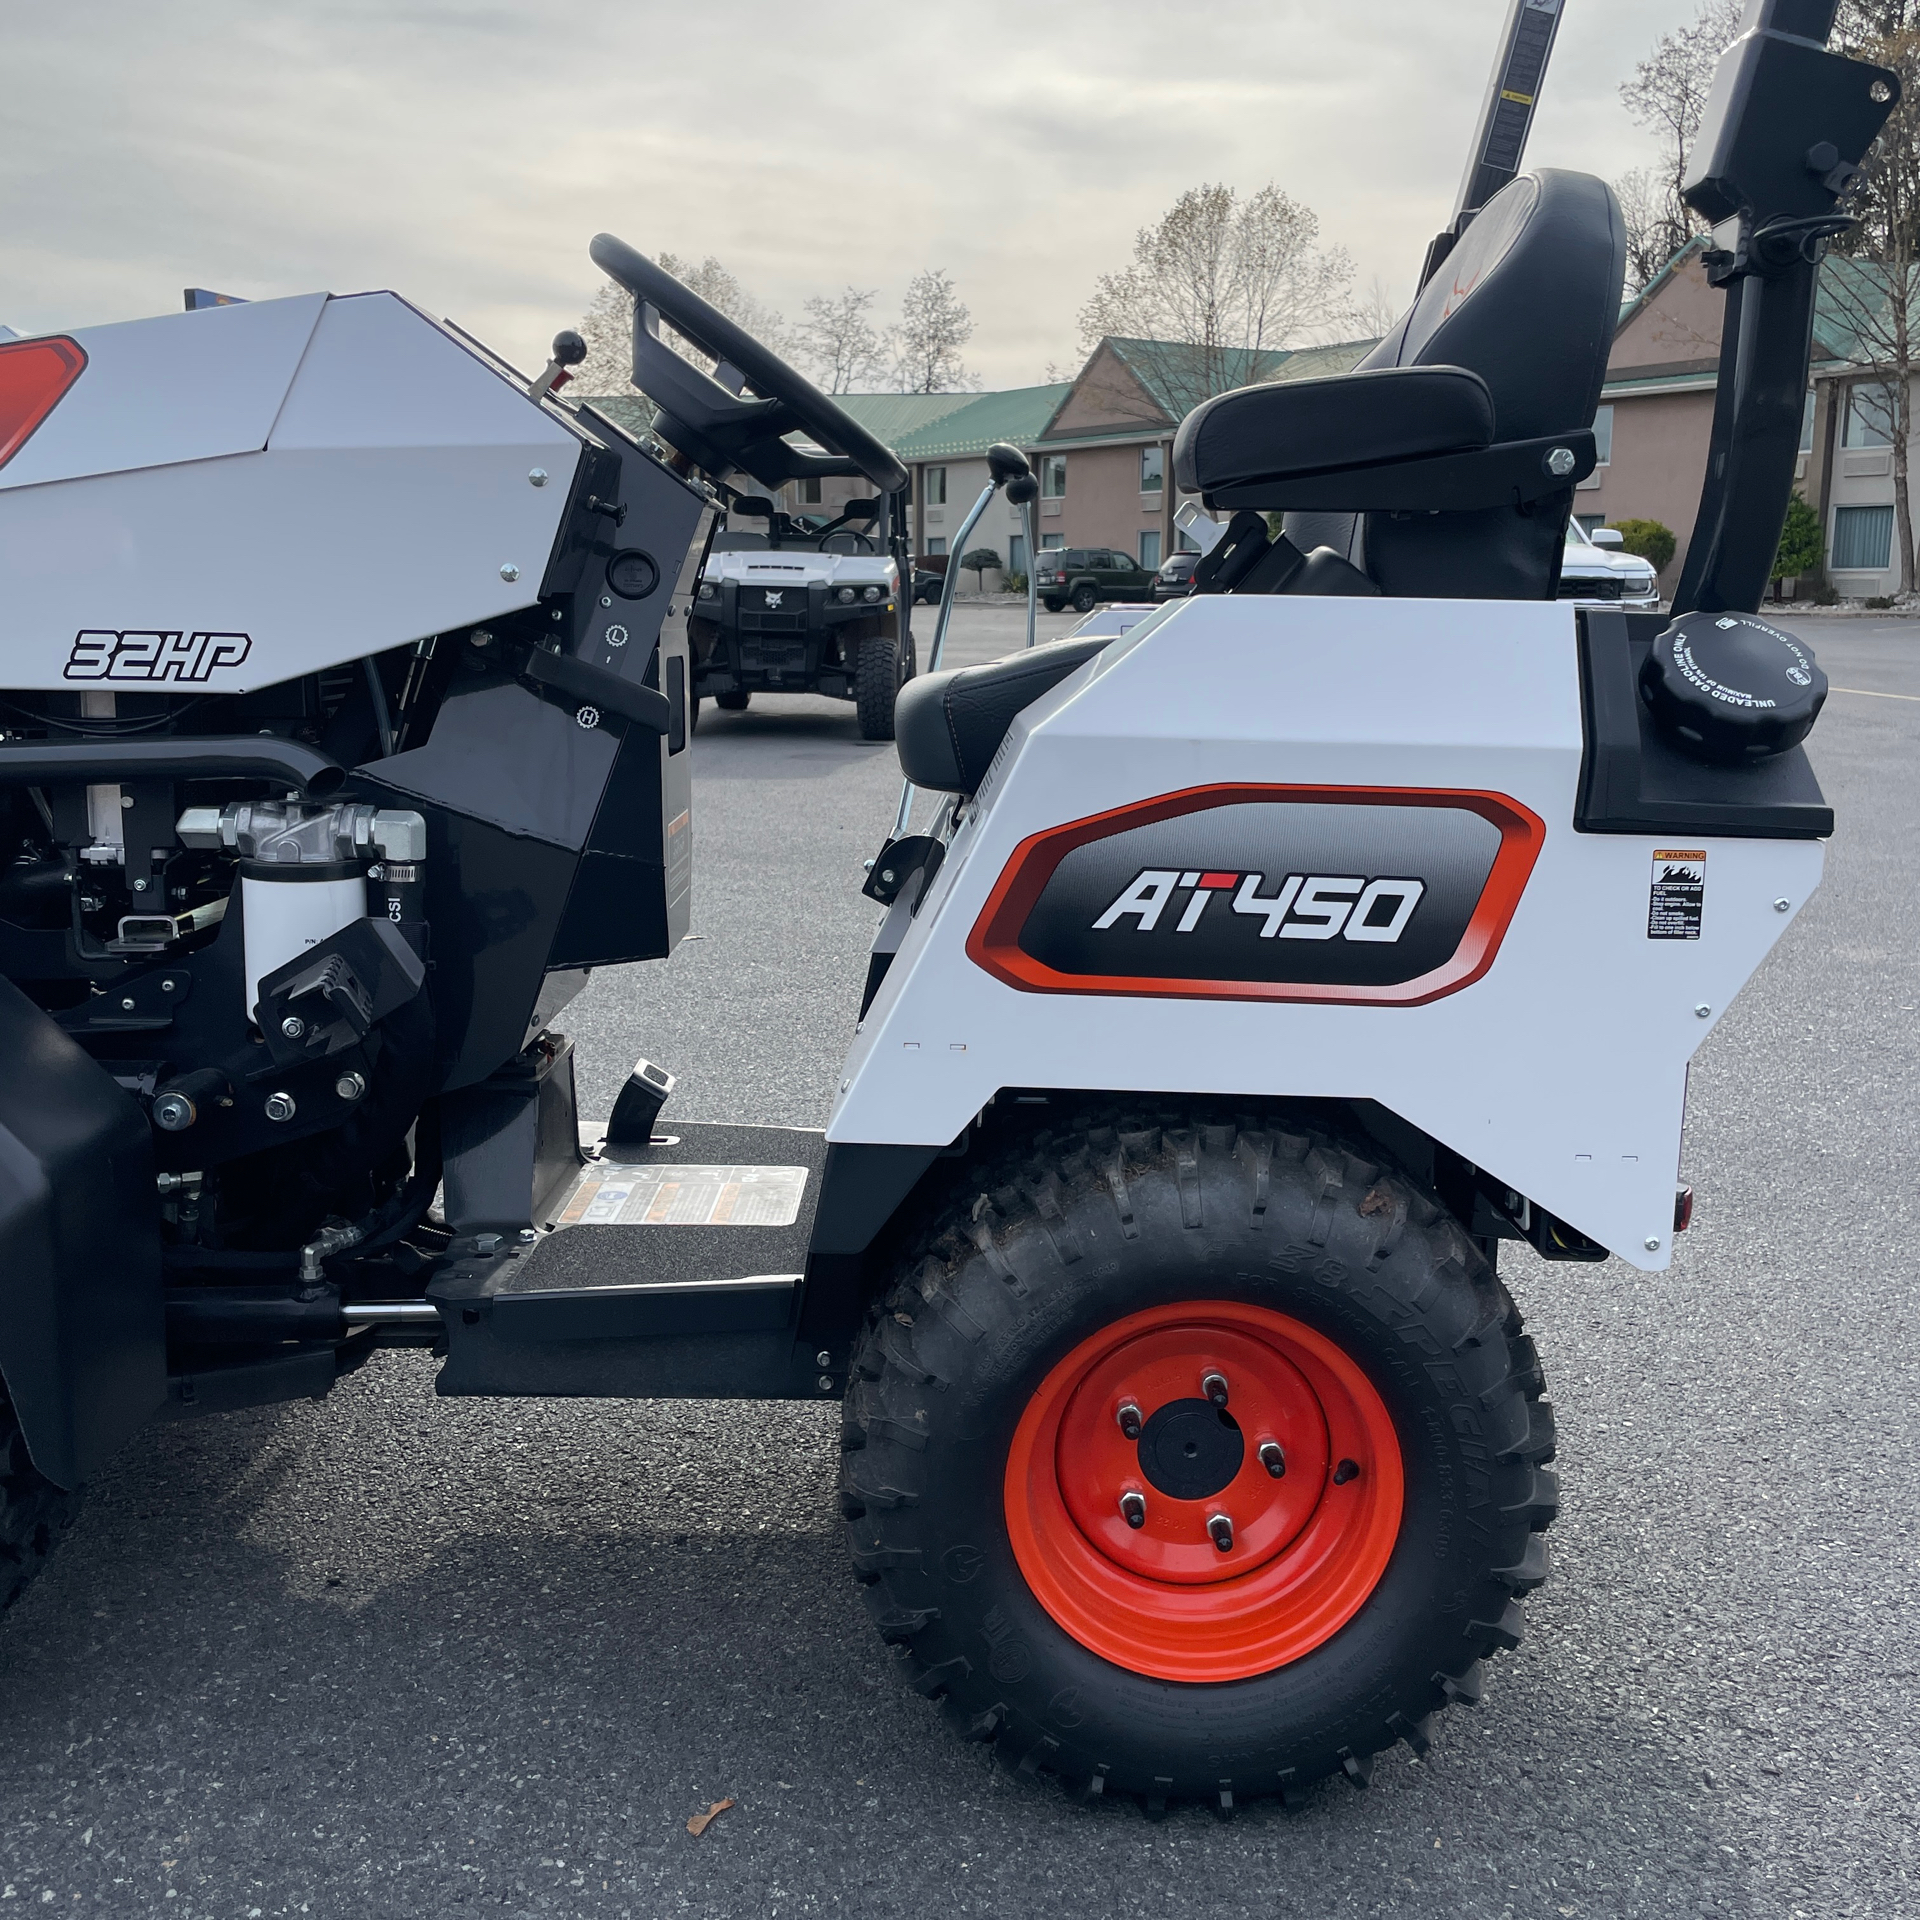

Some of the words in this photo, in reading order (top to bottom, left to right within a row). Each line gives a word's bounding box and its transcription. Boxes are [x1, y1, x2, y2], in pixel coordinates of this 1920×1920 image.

[1740, 619, 1787, 642] OVERFILL
[1673, 632, 1688, 652] ONLY
[1786, 643, 1803, 657] NOT
[64, 629, 252, 681] 32HP
[1798, 658, 1809, 669] DO
[1673, 653, 1711, 692] GASOLINE
[1711, 690, 1777, 708] UNLEADED
[1716, 684, 1753, 699] MAXIMUM
